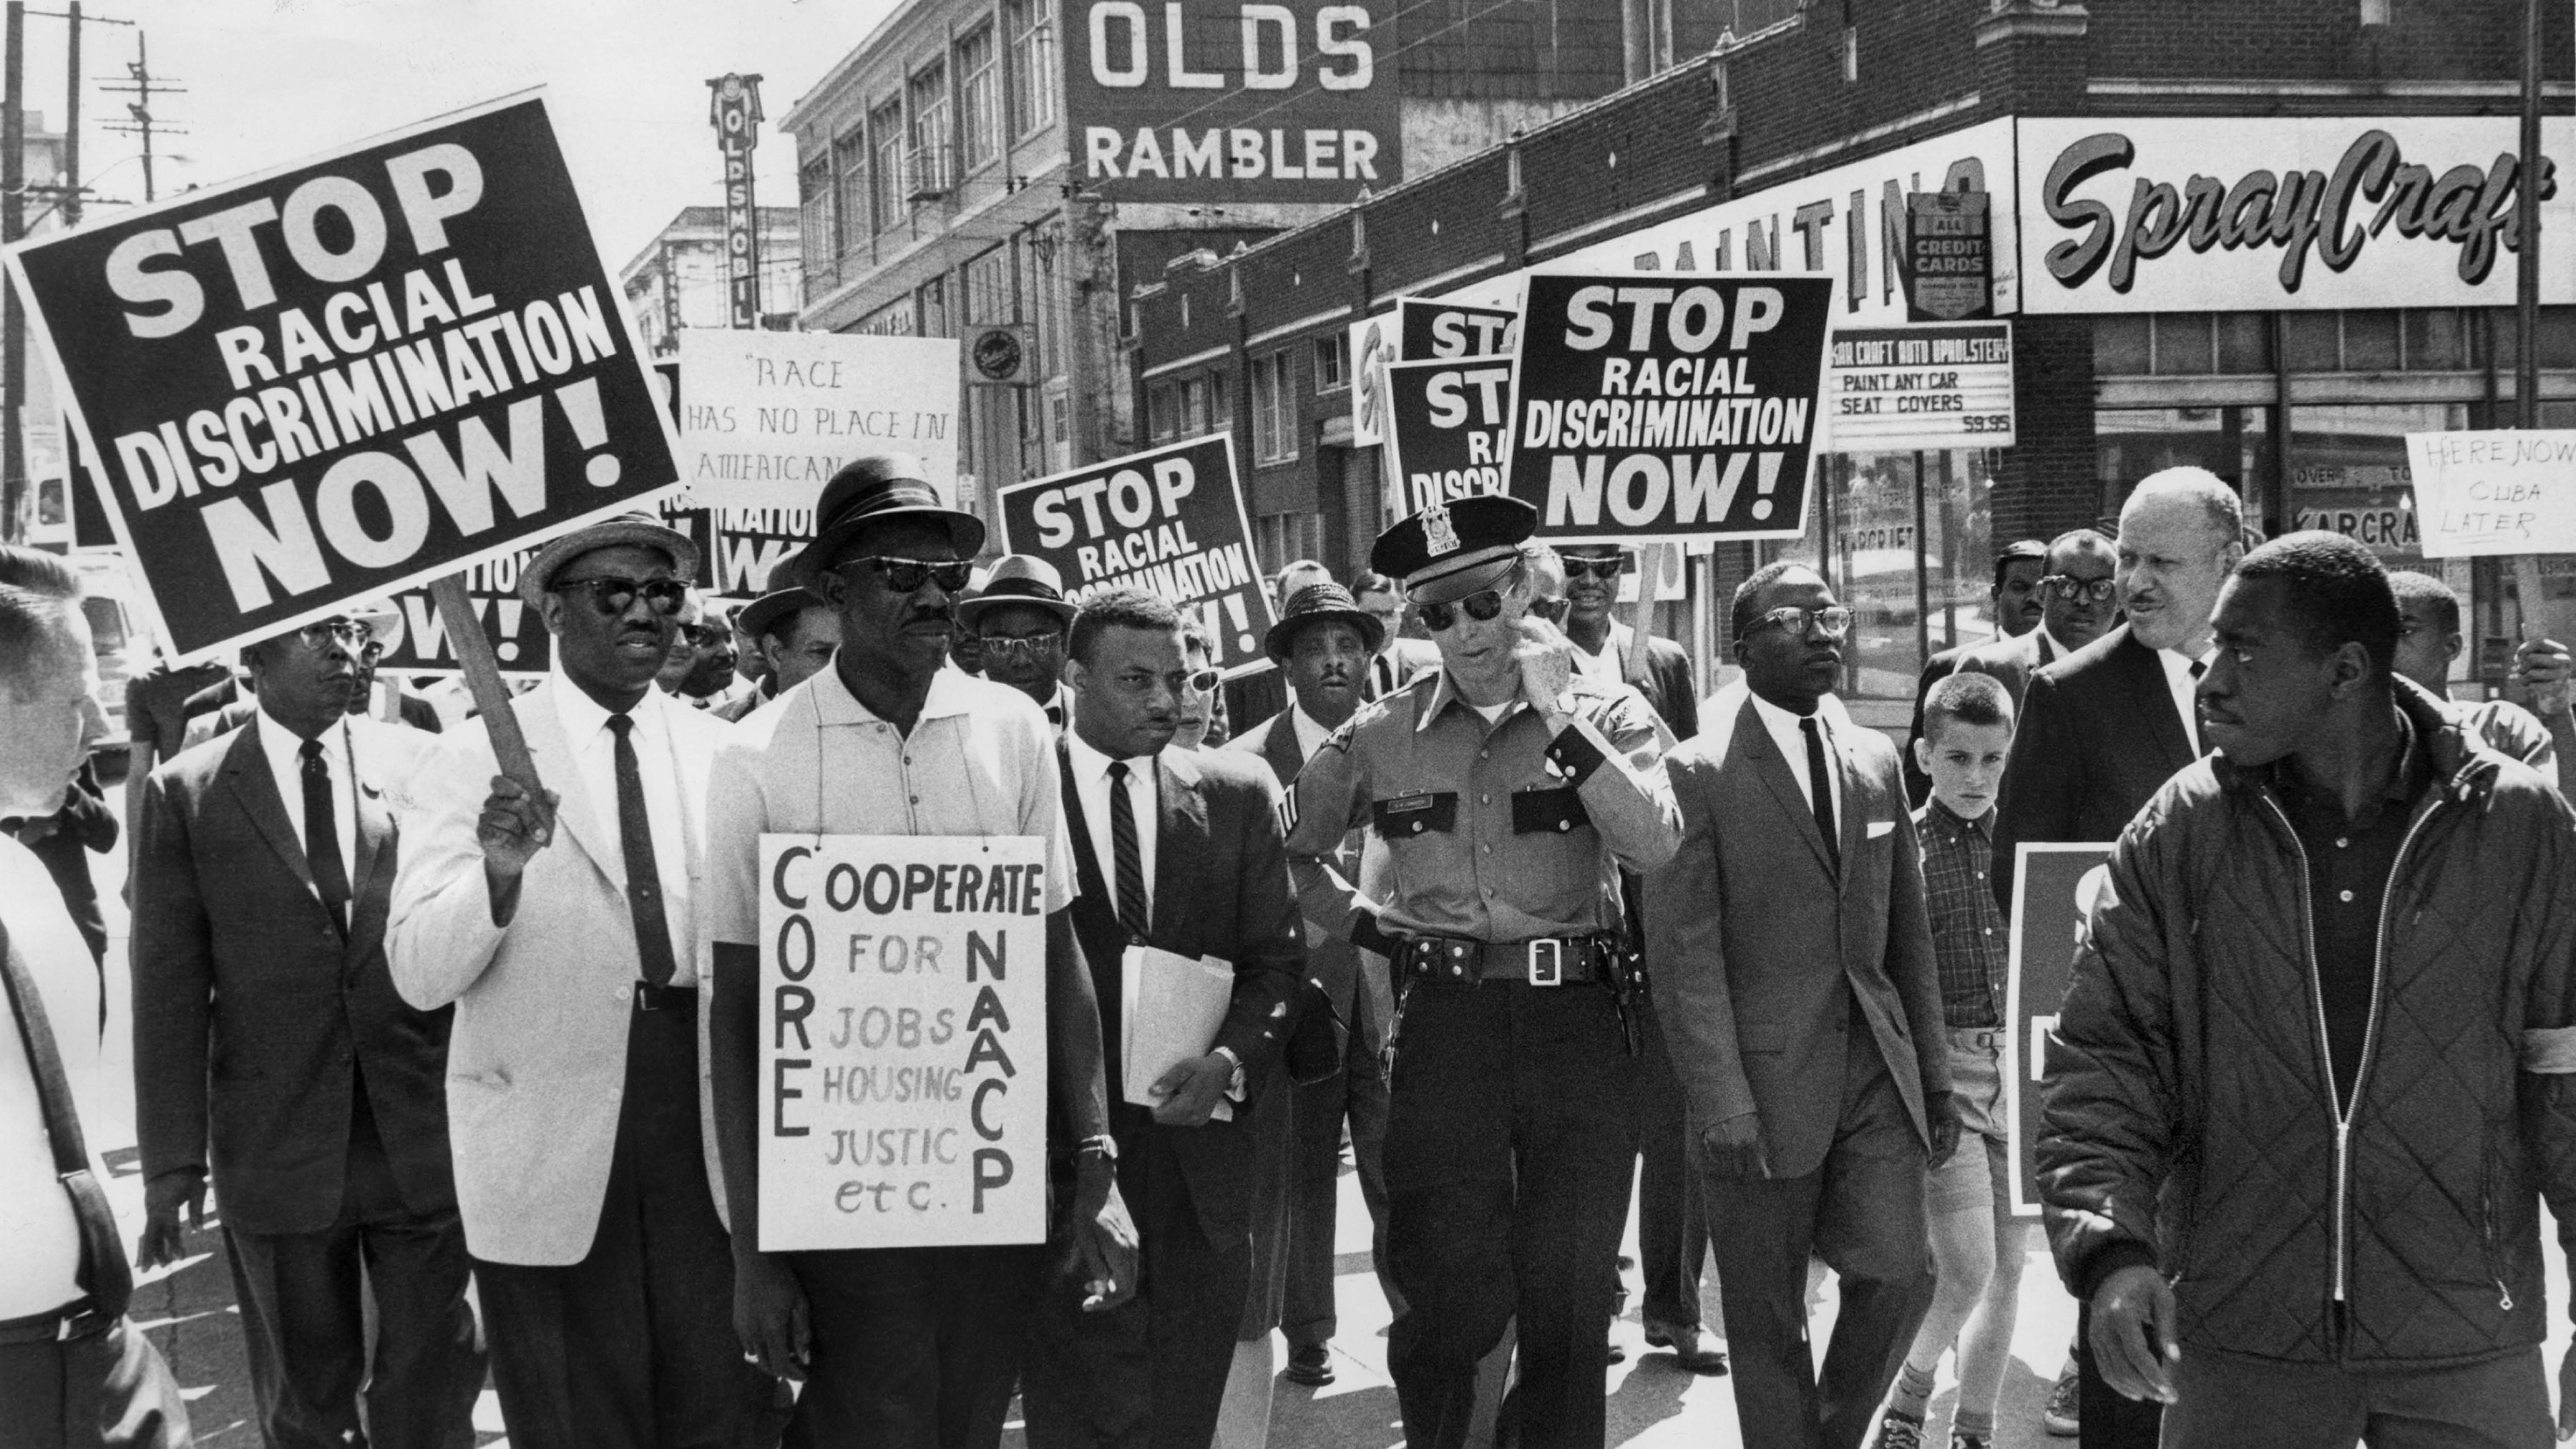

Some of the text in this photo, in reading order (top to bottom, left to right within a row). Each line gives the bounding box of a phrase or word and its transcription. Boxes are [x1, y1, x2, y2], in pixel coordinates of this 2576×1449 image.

[1088, 1, 1373, 89] OLDS
[1085, 127, 1378, 180] RAMBLER
[726, 109, 750, 325] OLDSMOBIL
[1937, 220, 1961, 230] ALL
[105, 144, 484, 338] STOP
[1916, 240, 1983, 255] CREDIT
[1916, 257, 1984, 272] CARDS
[215, 258, 496, 390] RACIAL
[1433, 311, 1518, 358] ST
[1565, 286, 1784, 353] STOP
[1855, 340, 1895, 365] CRAFT
[1898, 339, 1929, 364] AUTO
[1932, 338, 2009, 364] UPHOLSTERY
[1601, 357, 1755, 396] RACIAL
[1843, 371, 1958, 391] PAINT ANY CAR
[114, 286, 616, 510] DISCRIMINATION
[1426, 368, 1509, 429] ST
[1841, 394, 1963, 414] SEAT COVERS
[688, 405, 950, 440] HAS NO PLACE IN
[1524, 397, 1808, 448] DISCRIMINATION
[697, 453, 843, 482] AMERICAN
[2426, 438, 2576, 467] HERE NOW
[200, 377, 620, 613] NOW!
[1033, 457, 1196, 548] STOP
[1546, 452, 1785, 526] NOW!
[2469, 480, 2541, 502] CUBA
[2292, 512, 2418, 547] KARCRA
[2440, 511, 2536, 539] LATER
[1077, 520, 1199, 581] RACIAL
[848, 933, 943, 974] FOR
[829, 1007, 955, 1050] JOBS
[823, 1066, 964, 1103] HOUSING
[963, 930, 1017, 1214] NAACP
[824, 1128, 958, 1166] JUSTIC
[834, 1180, 947, 1214] etc.
